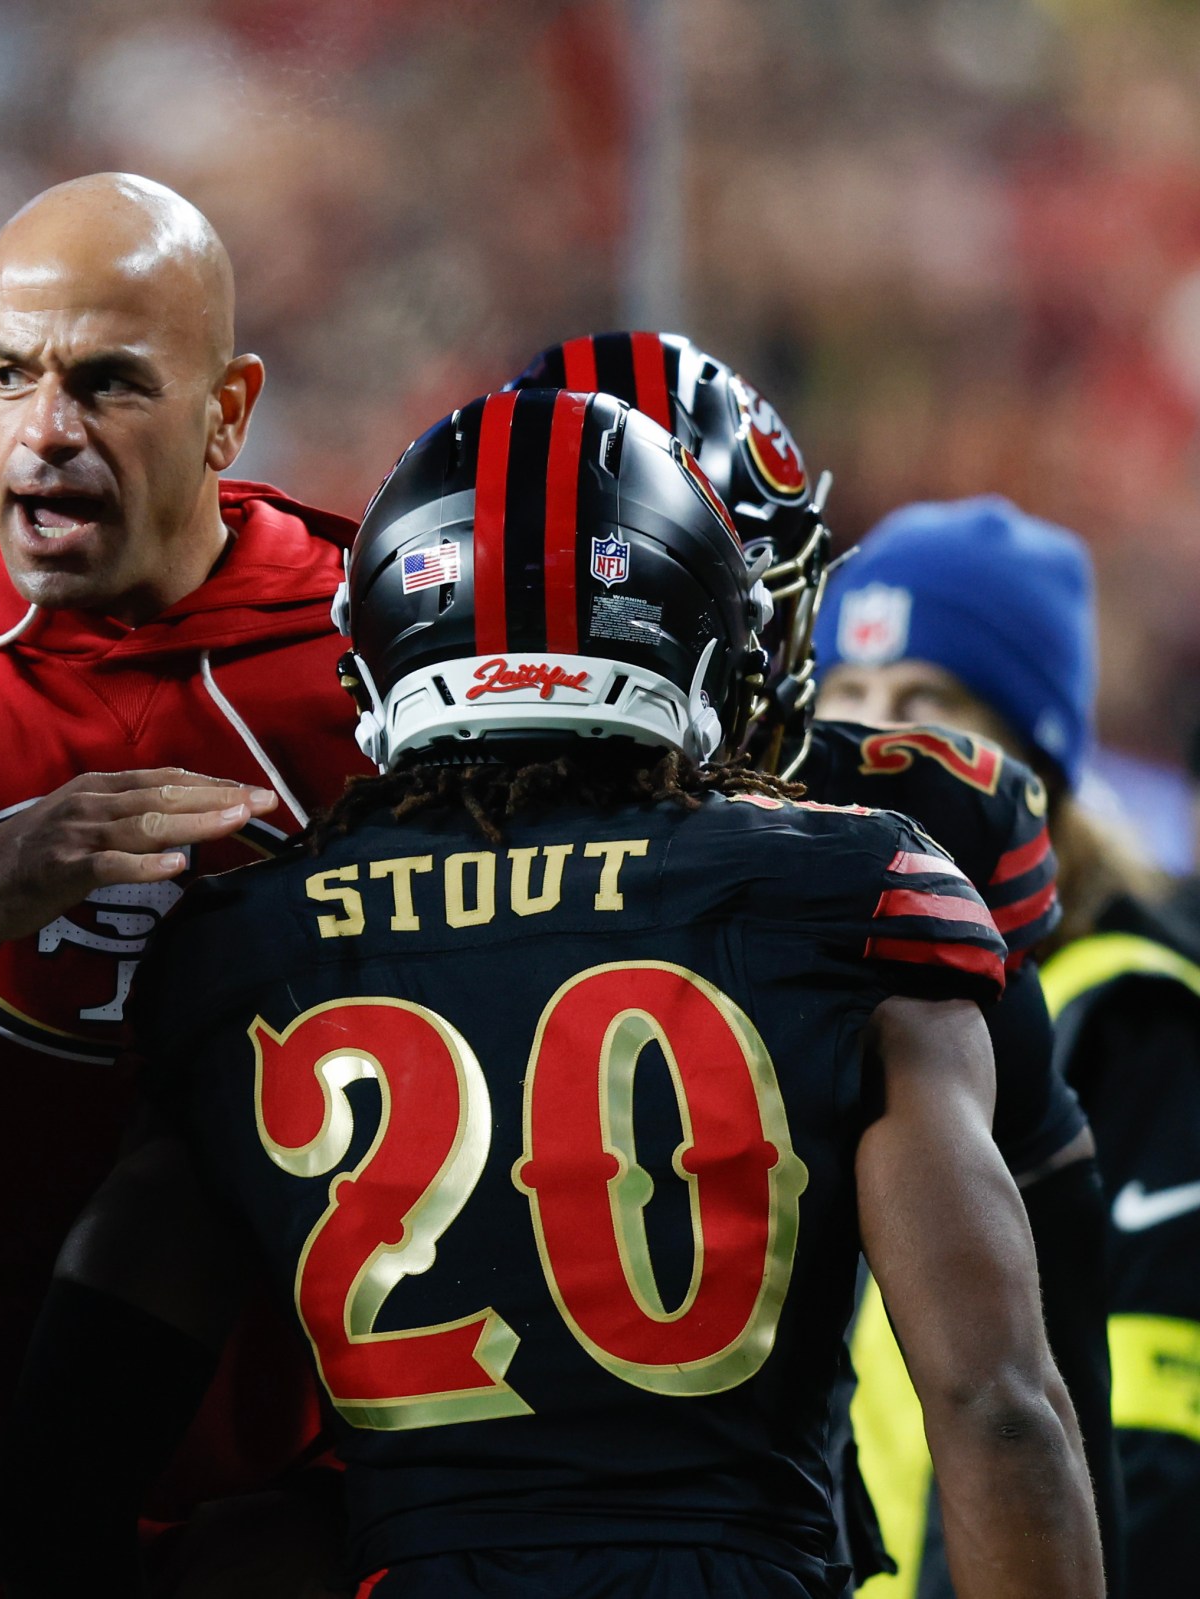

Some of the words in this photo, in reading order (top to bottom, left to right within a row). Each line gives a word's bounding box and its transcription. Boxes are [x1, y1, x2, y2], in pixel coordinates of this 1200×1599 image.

[596, 555, 624, 578] NFL
[612, 594, 648, 605] WARNING
[466, 658, 588, 700] Faithful
[305, 839, 650, 938] STOUT
[247, 960, 809, 1430] 20
